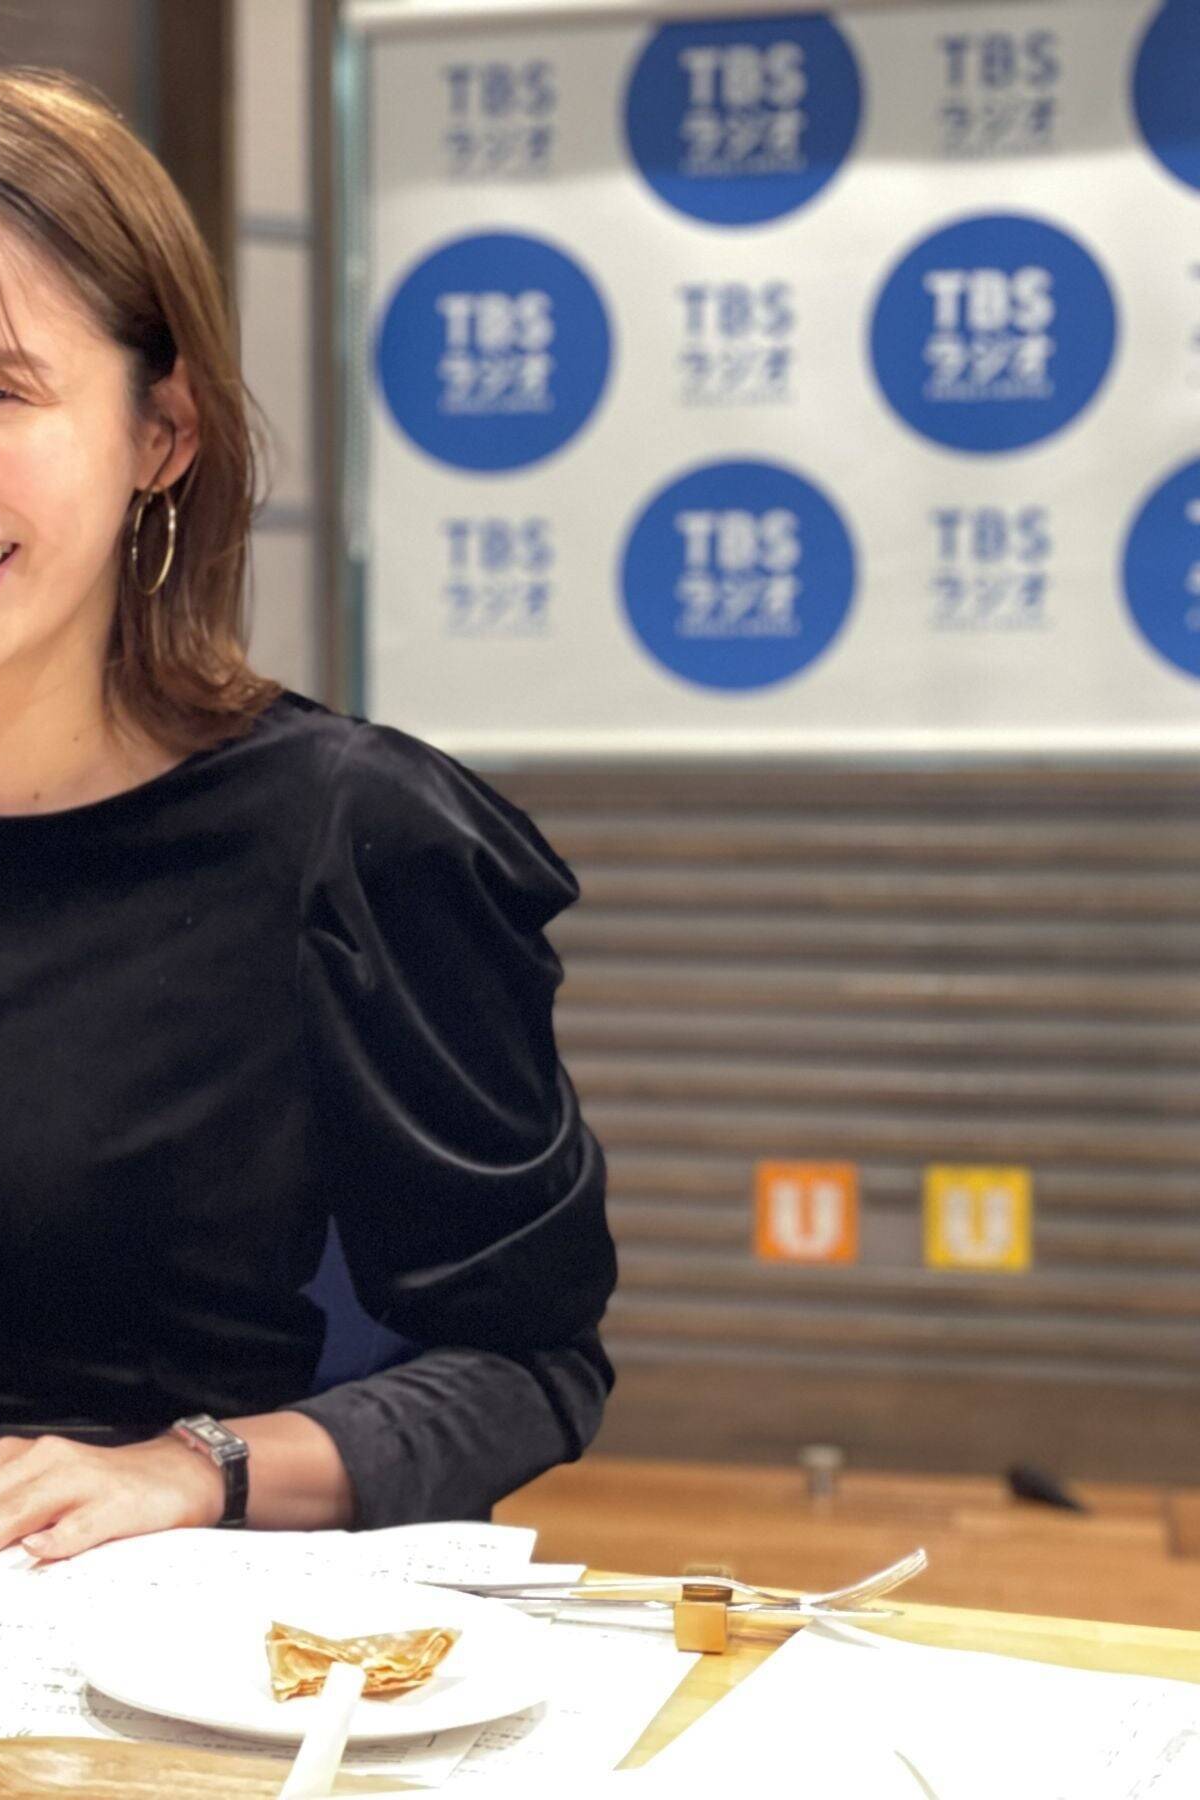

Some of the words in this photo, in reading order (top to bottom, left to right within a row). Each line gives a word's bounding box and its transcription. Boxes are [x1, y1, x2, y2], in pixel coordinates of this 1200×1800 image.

[441, 60, 555, 118] TBS
[678, 42, 807, 108] TBS
[938, 29, 1060, 88] TBS
[436, 290, 554, 355] TBS
[676, 281, 797, 337] TBS
[923, 266, 1055, 333] TBS
[440, 515, 553, 573] TBS
[675, 507, 801, 573] TBS
[928, 504, 1052, 564] TBS
[770, 1179, 844, 1260] U
[940, 1185, 1016, 1265] U
